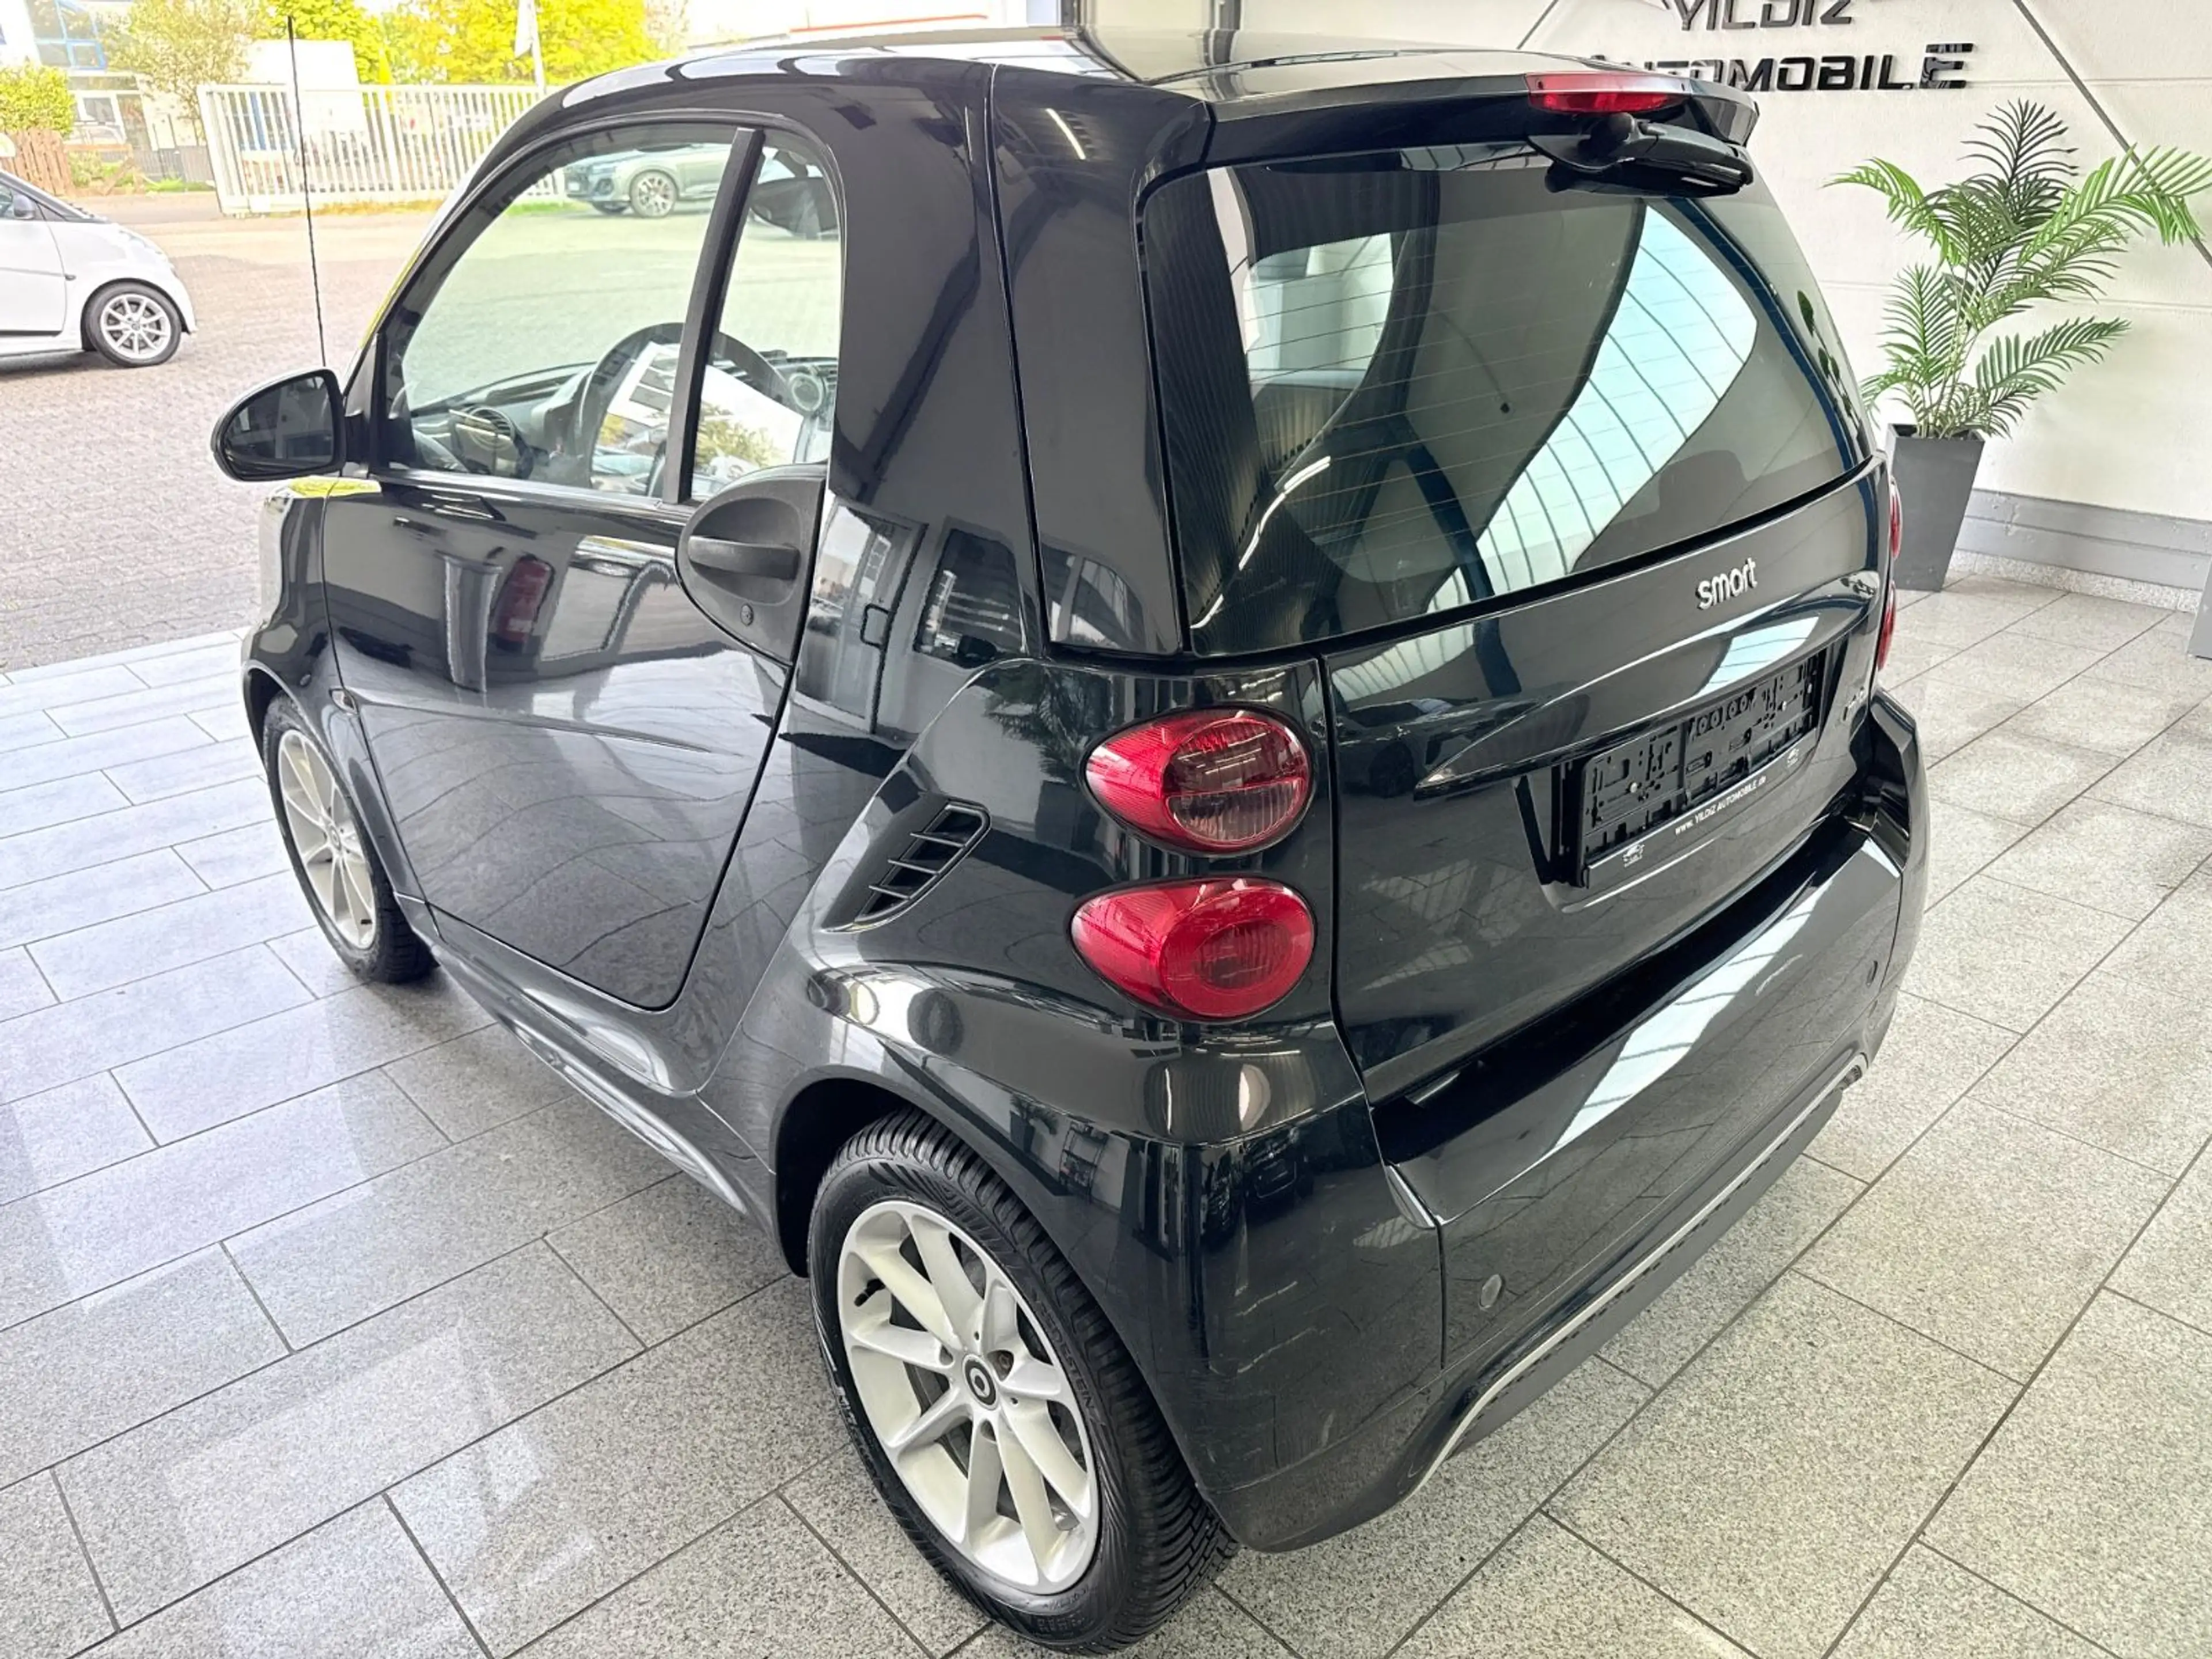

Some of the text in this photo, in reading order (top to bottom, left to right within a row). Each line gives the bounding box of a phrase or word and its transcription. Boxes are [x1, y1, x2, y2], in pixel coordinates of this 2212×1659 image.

[1696, 556, 1758, 610] smart
[1695, 804, 1716, 823] YILDIZ
[1717, 779, 1757, 812] AUTOMOBILE
